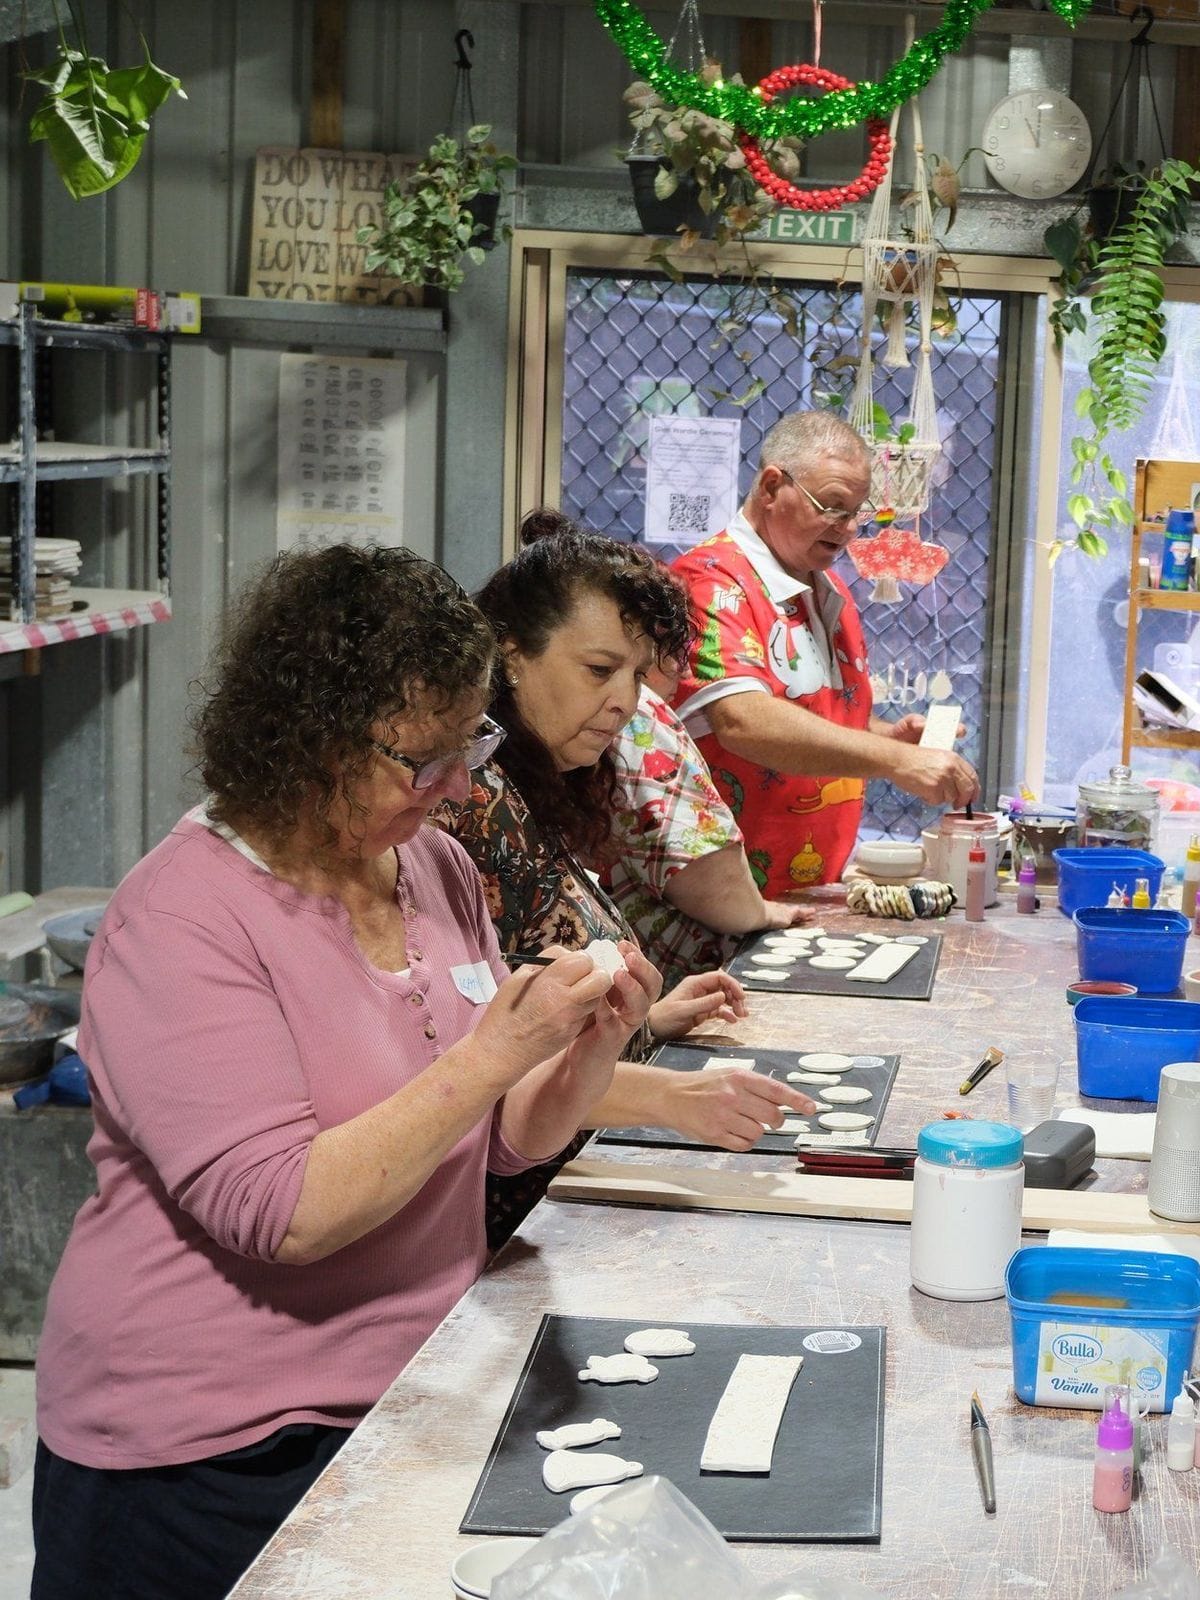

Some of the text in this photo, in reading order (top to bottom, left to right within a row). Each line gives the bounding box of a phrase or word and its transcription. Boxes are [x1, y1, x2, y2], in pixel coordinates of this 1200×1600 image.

[988, 136, 999, 149] 9
[262, 155, 312, 187] DO
[995, 157, 1007, 172] 8
[1012, 173, 1023, 188] 7
[1032, 179, 1043, 194] 6
[262, 196, 386, 232] YOU LO
[778, 214, 846, 239] EXIT
[257, 239, 331, 275] LOVE
[1057, 1339, 1096, 1358] Bulla
[1051, 1377, 1099, 1395] Vanilla
